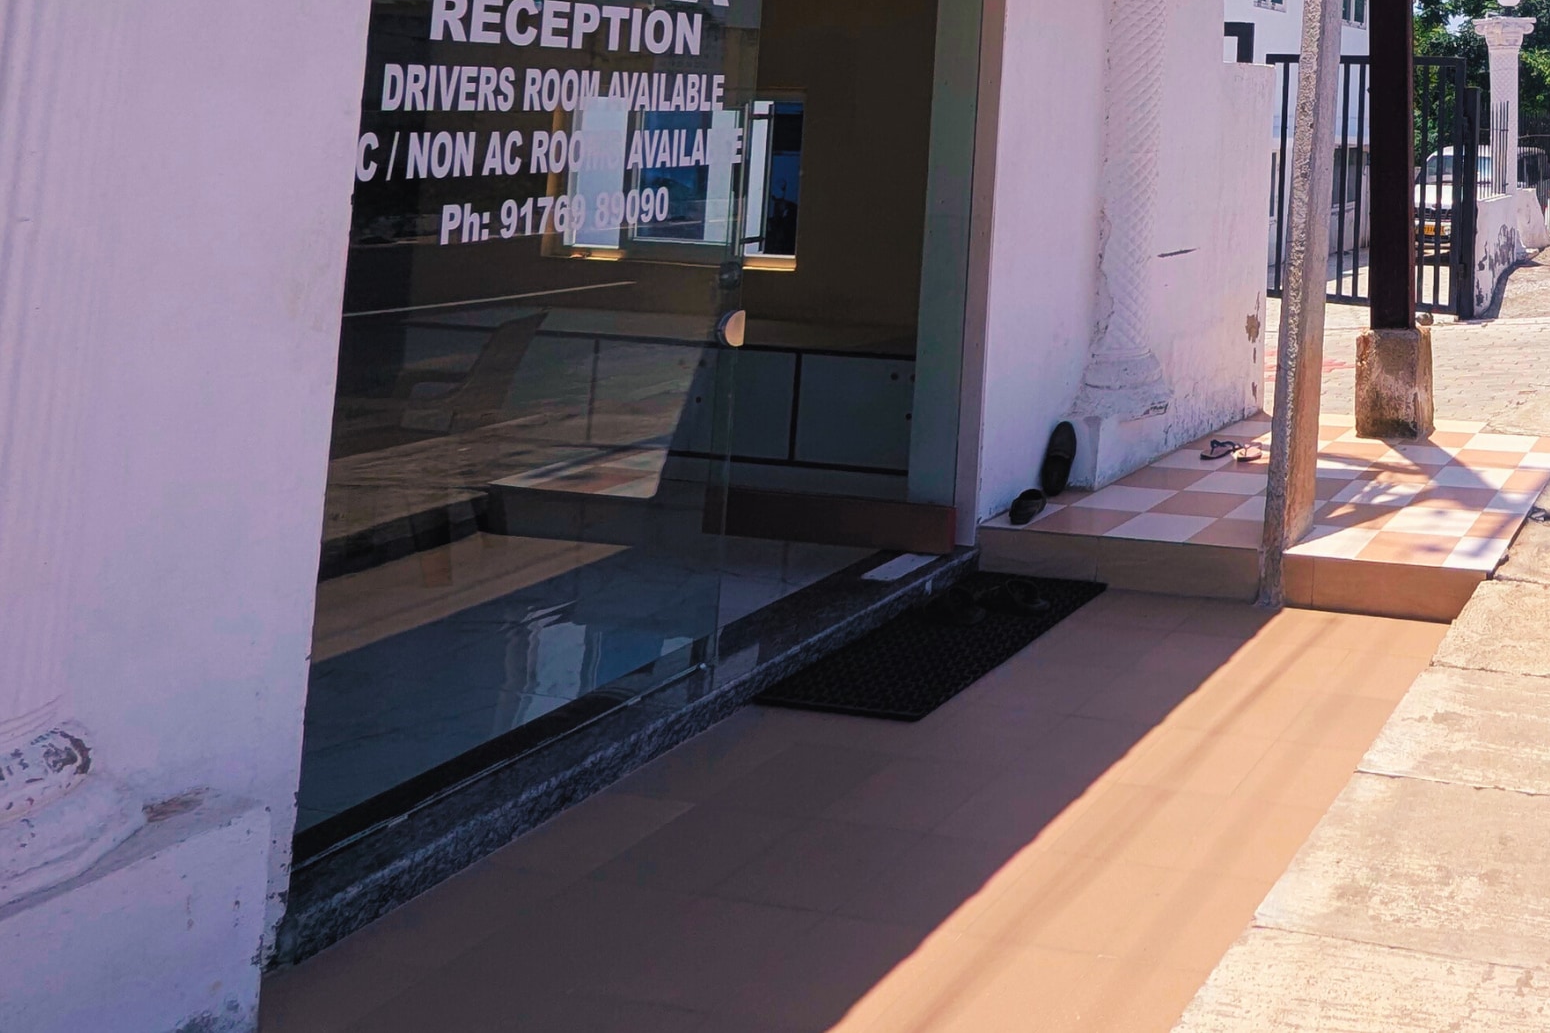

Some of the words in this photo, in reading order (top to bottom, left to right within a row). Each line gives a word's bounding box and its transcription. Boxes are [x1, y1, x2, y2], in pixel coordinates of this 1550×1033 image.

[381, 63, 516, 112] DRIVERS
[522, 68, 601, 112] ROOM
[605, 71, 726, 112] AVAILABLE
[405, 130, 477, 180] NON
[481, 130, 523, 176] AC
[626, 127, 743, 171] AVAILAE
[440, 202, 491, 246] Ph:
[500, 193, 587, 239] 91769
[593, 185, 670, 230] 89090
